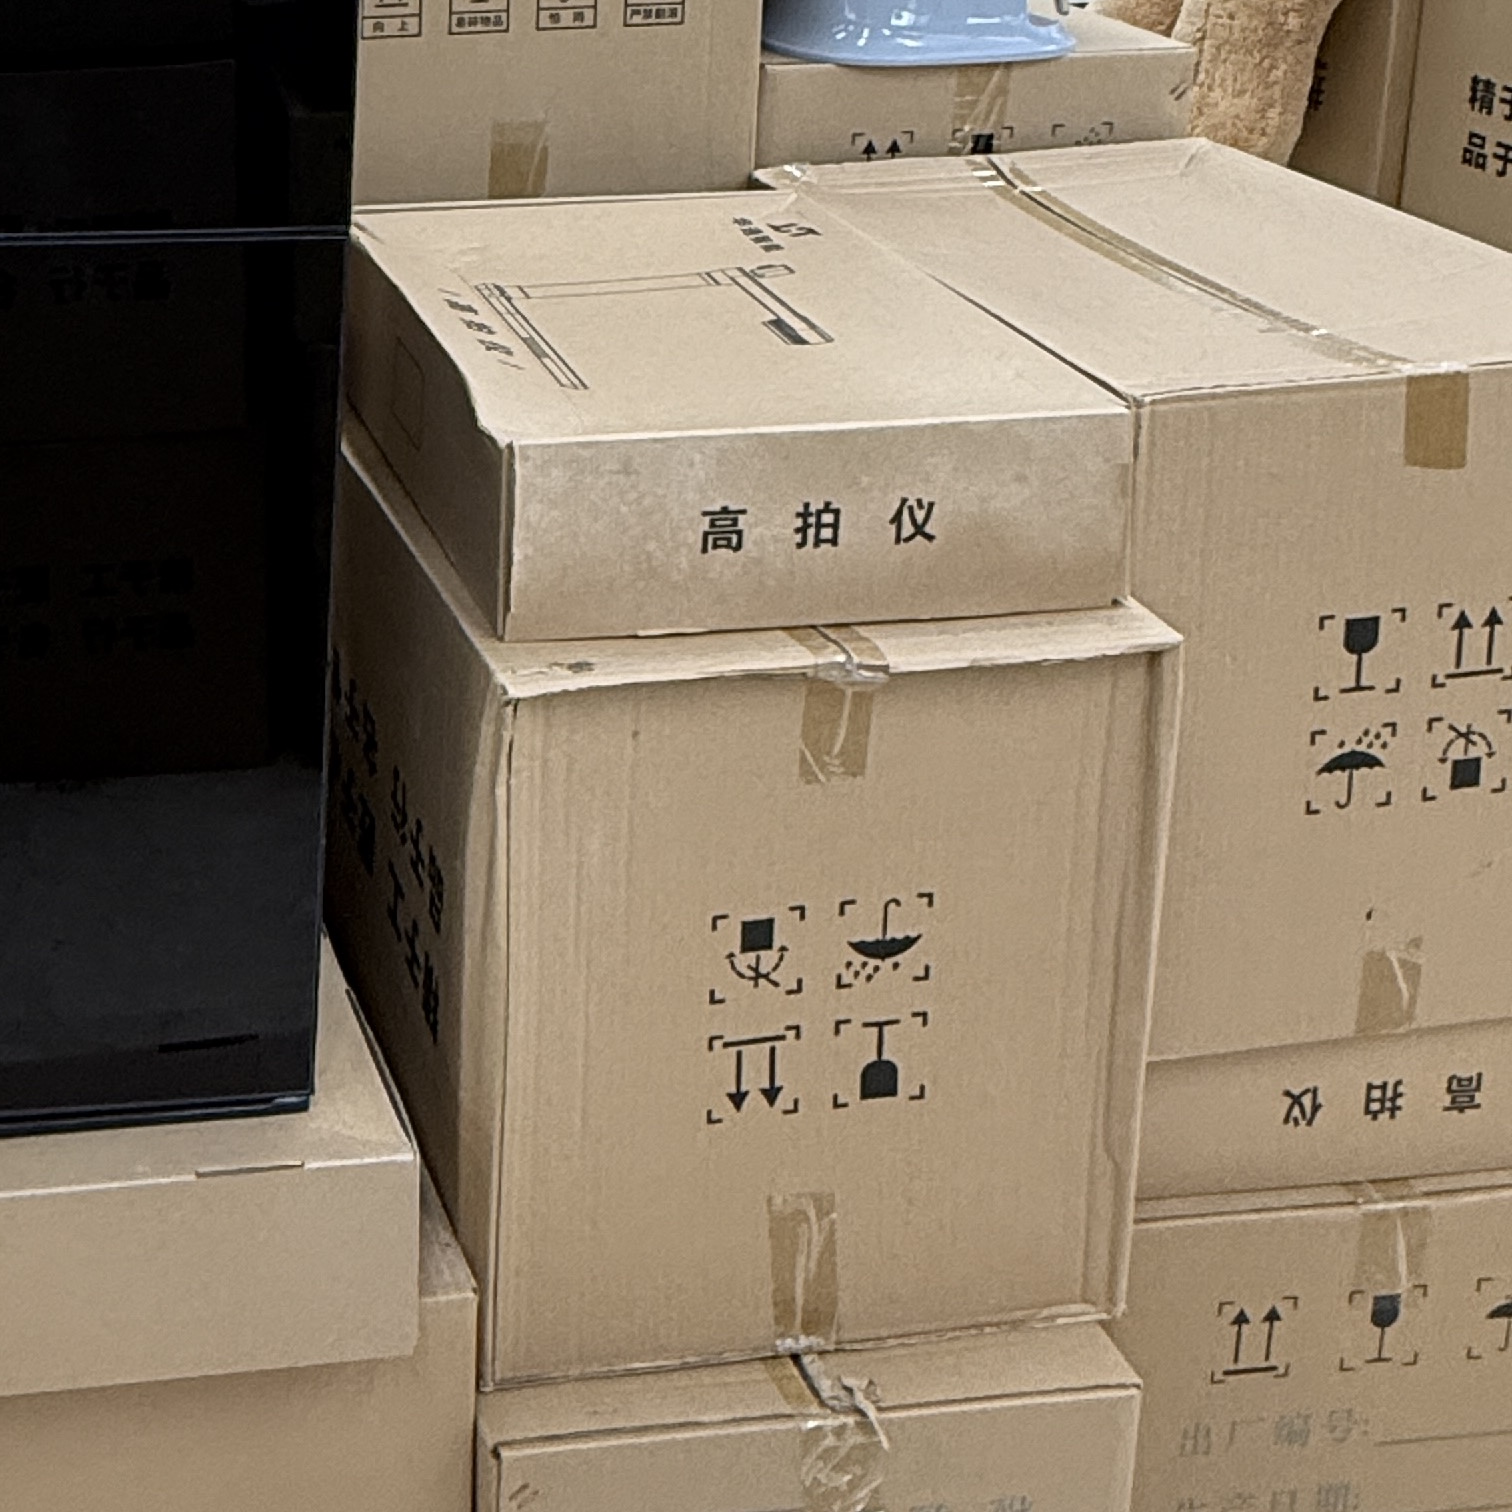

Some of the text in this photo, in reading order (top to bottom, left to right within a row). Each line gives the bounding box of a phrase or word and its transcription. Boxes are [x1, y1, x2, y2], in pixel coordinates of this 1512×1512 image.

[372, 20, 409, 33] 向上
[699, 495, 938, 555] 高拍仪
[1282, 1071, 1484, 1126] 高拍仪
